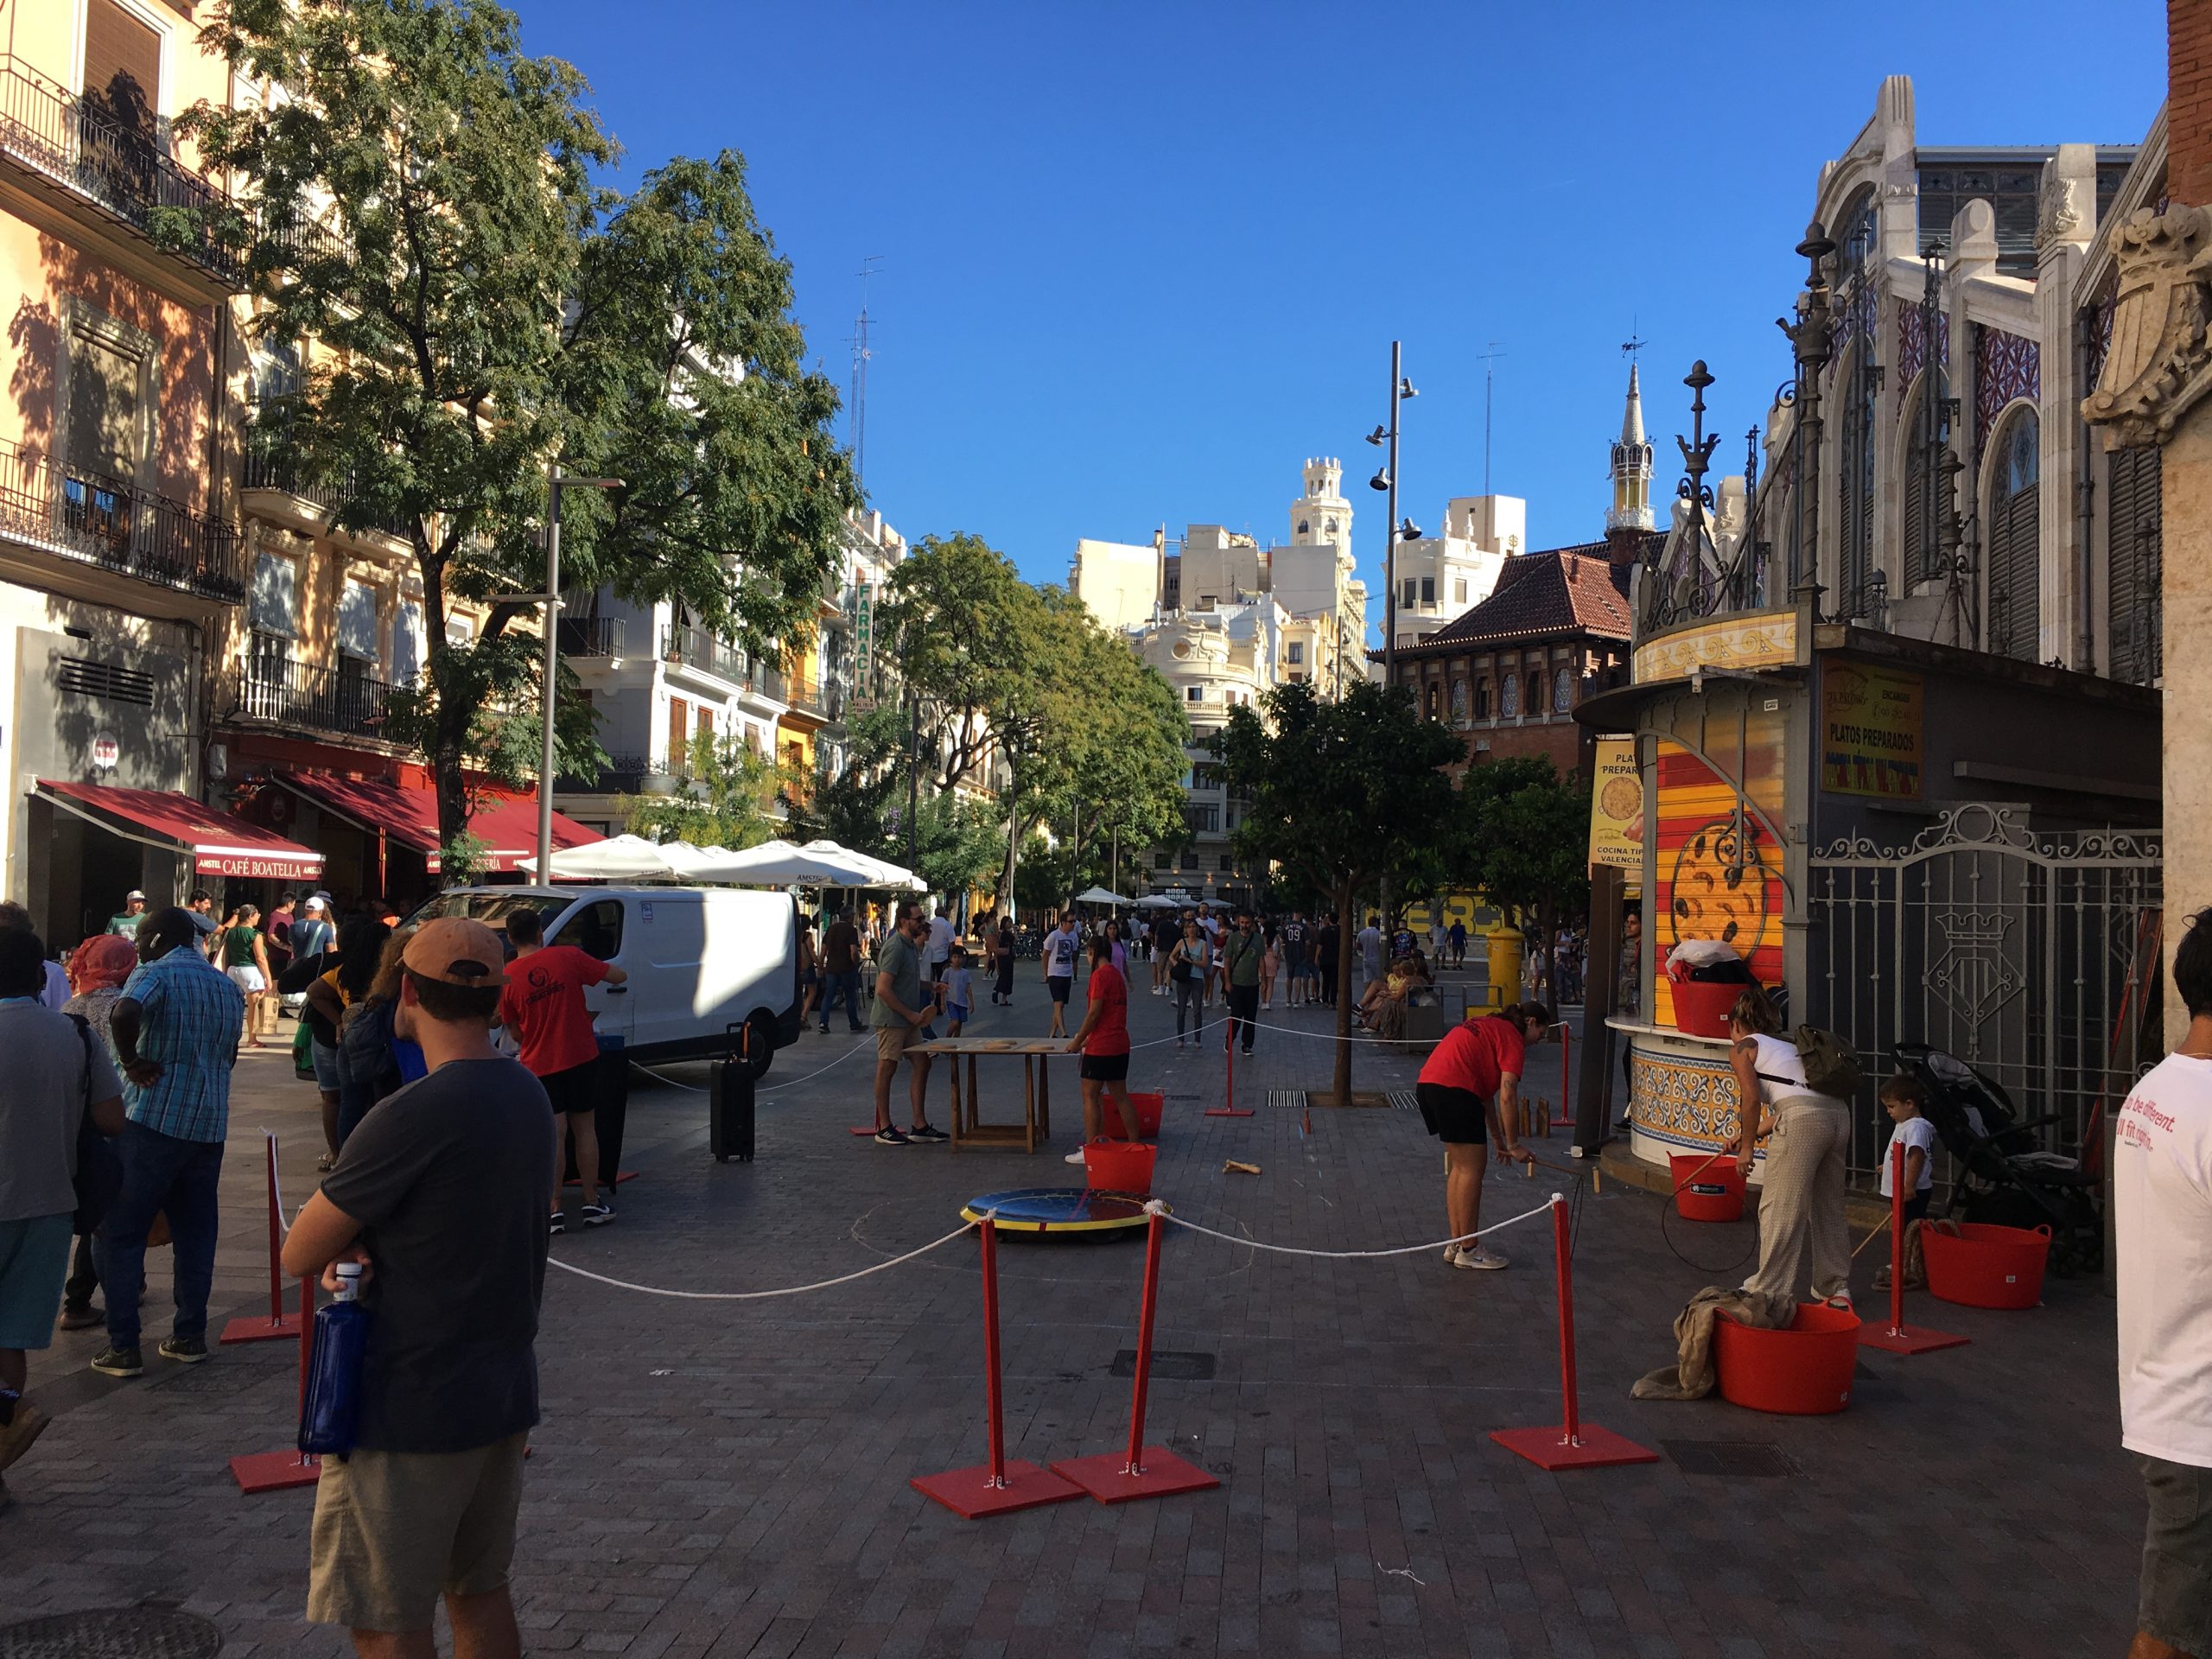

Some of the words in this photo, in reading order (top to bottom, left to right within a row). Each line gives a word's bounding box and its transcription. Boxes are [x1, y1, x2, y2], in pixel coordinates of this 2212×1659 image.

[856, 585, 871, 699] FARMACIA
[1830, 722, 1861, 744] PLATOS
[1863, 727, 1914, 752] PREPARADOS
[1597, 846, 1628, 855] COCINA
[1601, 855, 1643, 864] VALENCIA
[198, 859, 221, 869] AMSTEL
[222, 857, 250, 874] CAFÉ
[251, 861, 301, 877] BOATELLA
[1287, 929, 1300, 942] 09
[2132, 1094, 2144, 1114] be
[2143, 1100, 2175, 1133] different.
